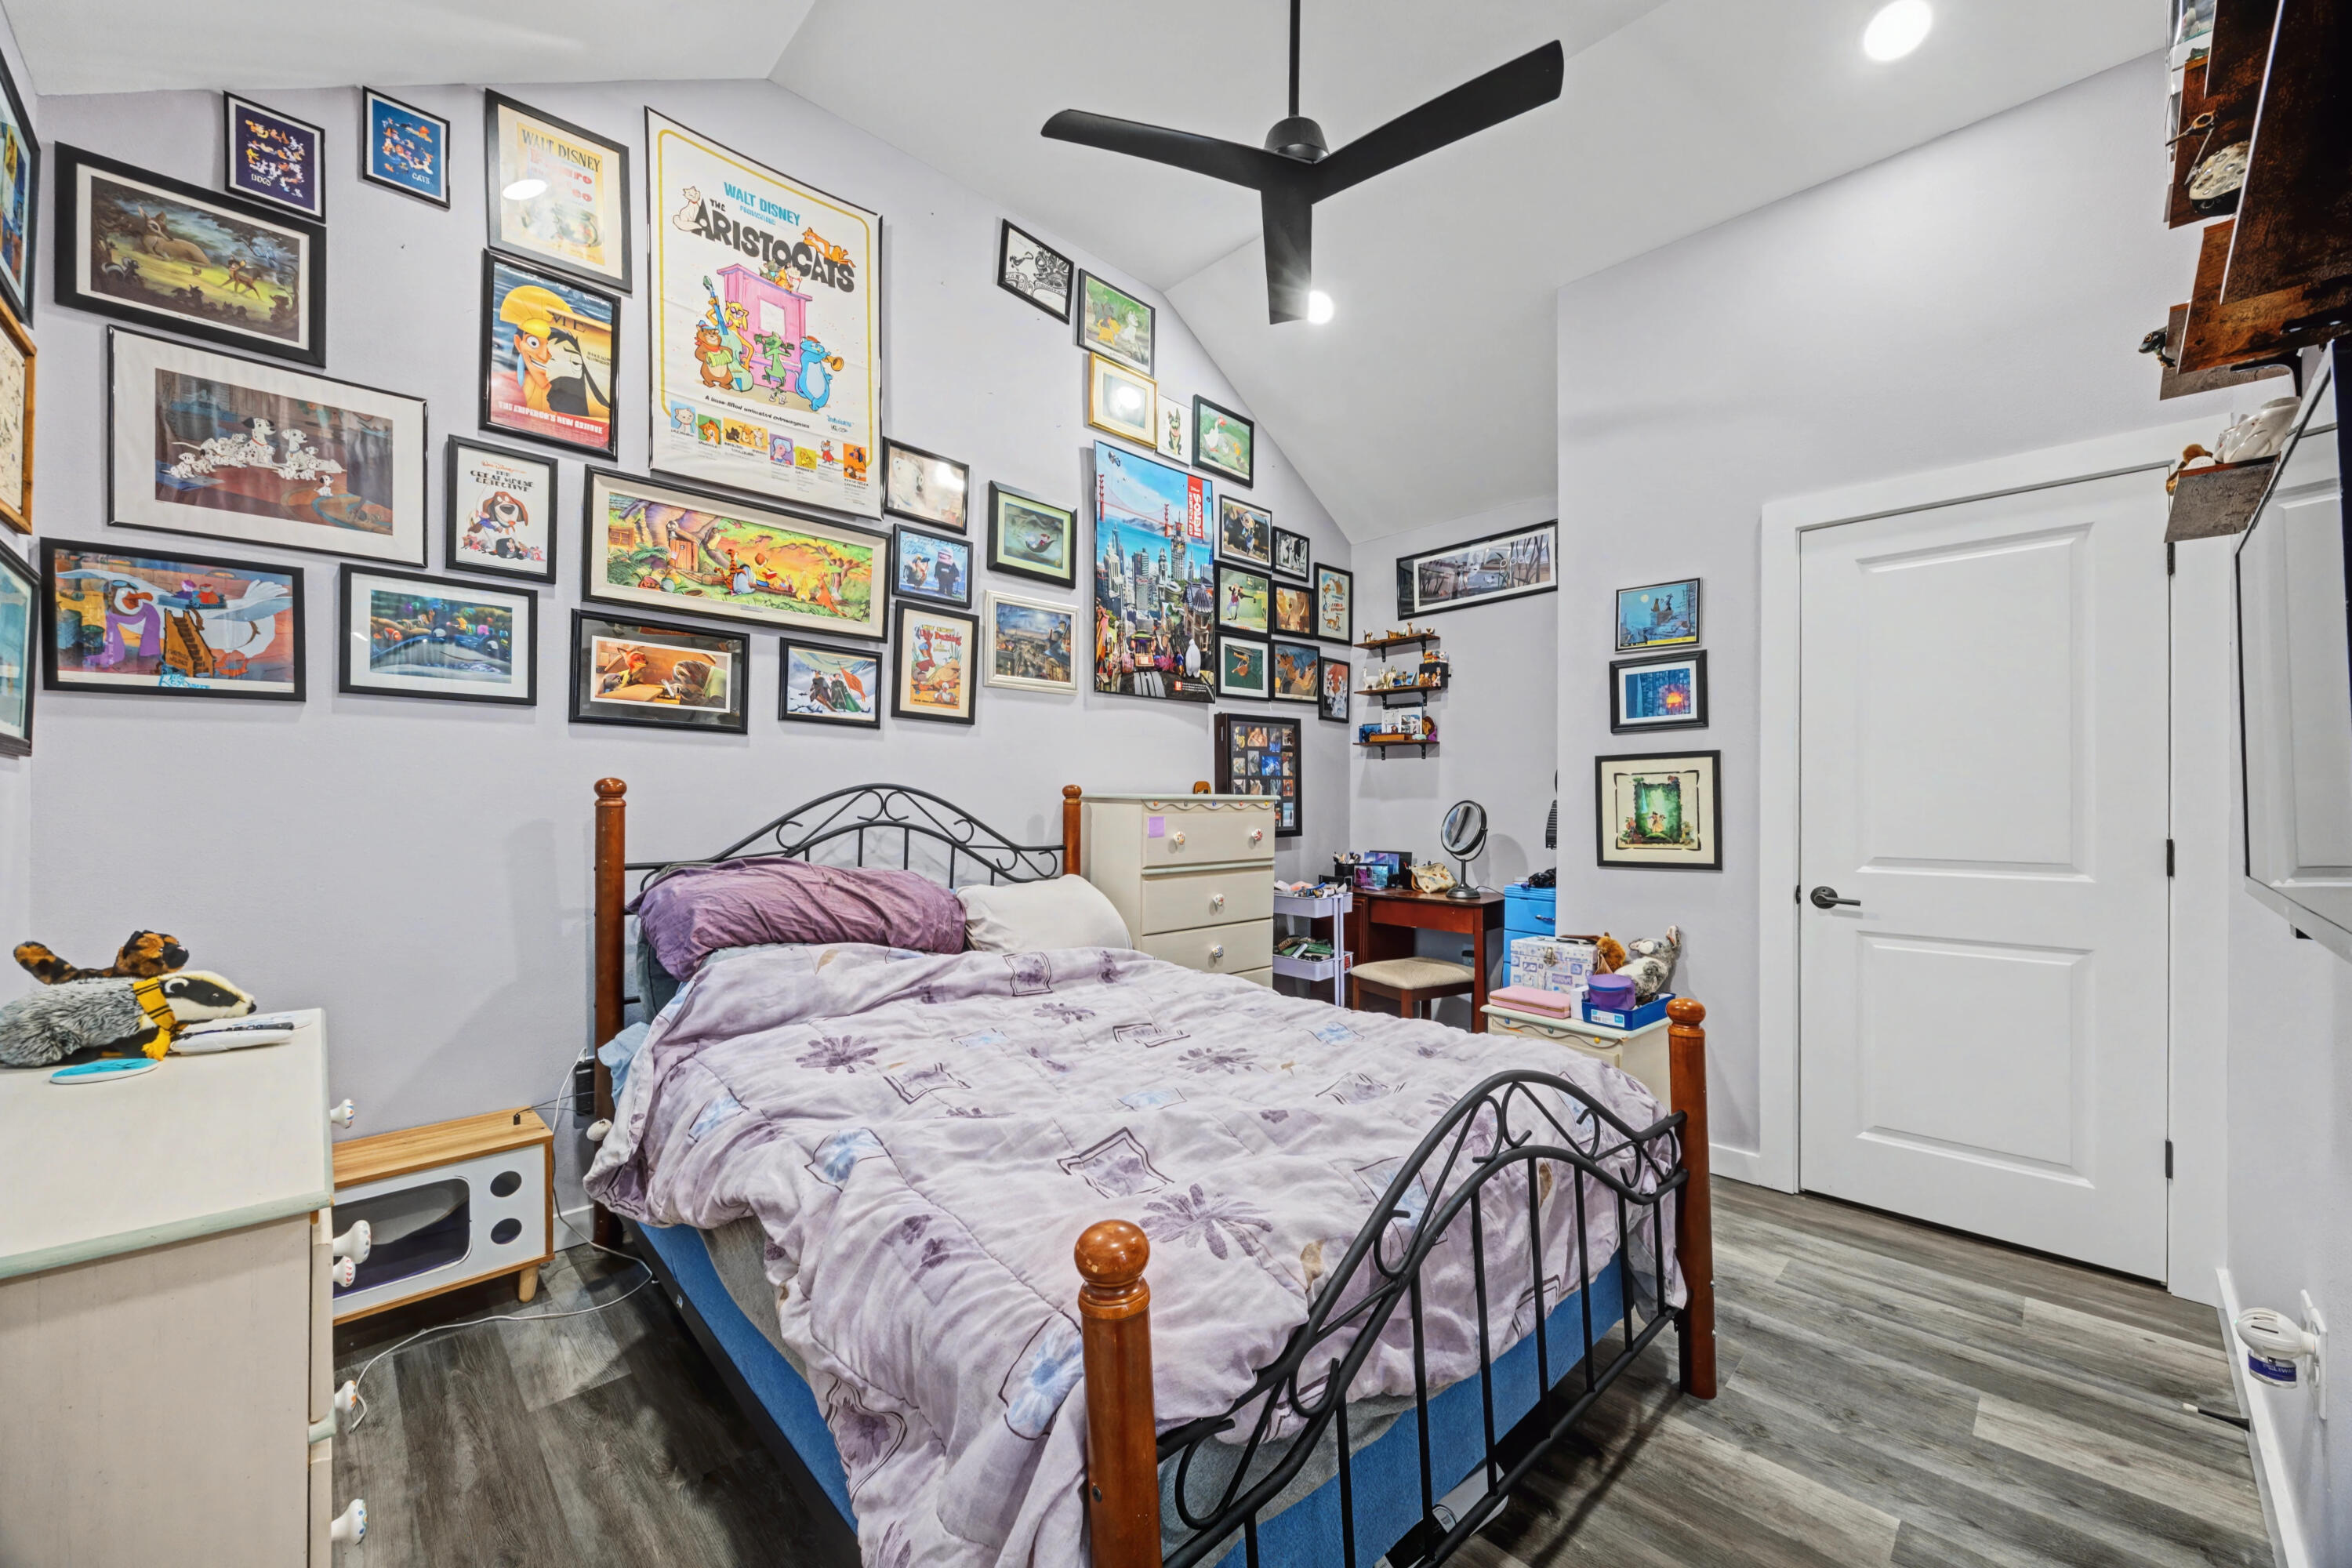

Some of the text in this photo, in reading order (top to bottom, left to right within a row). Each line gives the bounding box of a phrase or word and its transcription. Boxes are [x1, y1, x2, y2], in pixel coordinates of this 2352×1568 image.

[521, 128, 554, 154] WALT
[557, 143, 601, 173] DISNEY
[251, 173, 271, 187] DOGS
[412, 172, 430, 185] CATS
[710, 198, 726, 212] THE
[724, 181, 800, 227] WALT DISNEY
[691, 198, 855, 293] ARISTOCATS
[498, 401, 514, 412] THE
[557, 415, 574, 427] NEW
